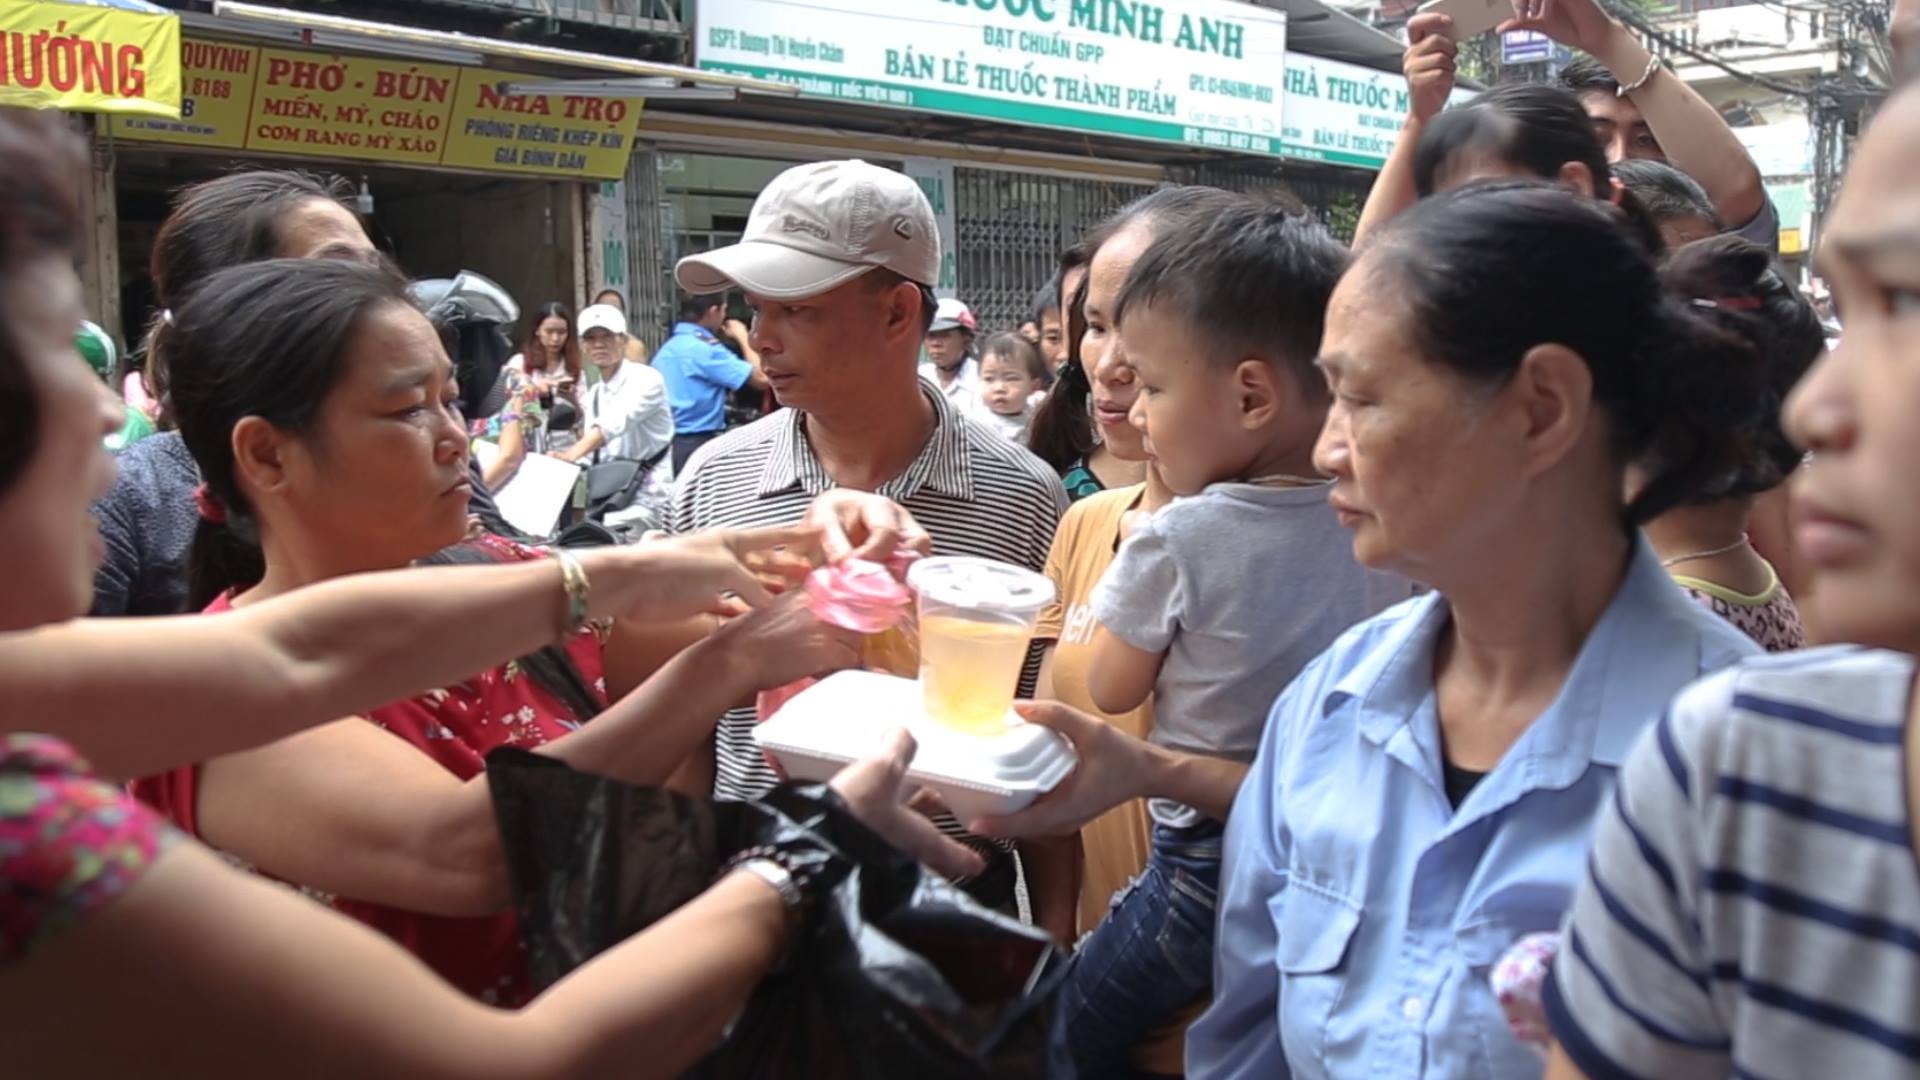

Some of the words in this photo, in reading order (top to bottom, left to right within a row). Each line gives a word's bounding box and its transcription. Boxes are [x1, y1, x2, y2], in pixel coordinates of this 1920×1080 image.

[1069, 0, 1164, 44] MINH
[1174, 14, 1245, 60] ANH
[266, 54, 349, 92] PHỞ
[373, 66, 450, 103] BÚN
[942, 51, 969, 85] LẺ
[975, 62, 1048, 98] THUỐC
[1054, 74, 1120, 109] THÀNH
[1326, 75, 1390, 110] THUỐC
[381, 109, 440, 131] CHÁO
[563, 95, 627, 128] TRỌ
[257, 124, 300, 142] CƠM
[305, 129, 361, 146] RANG
